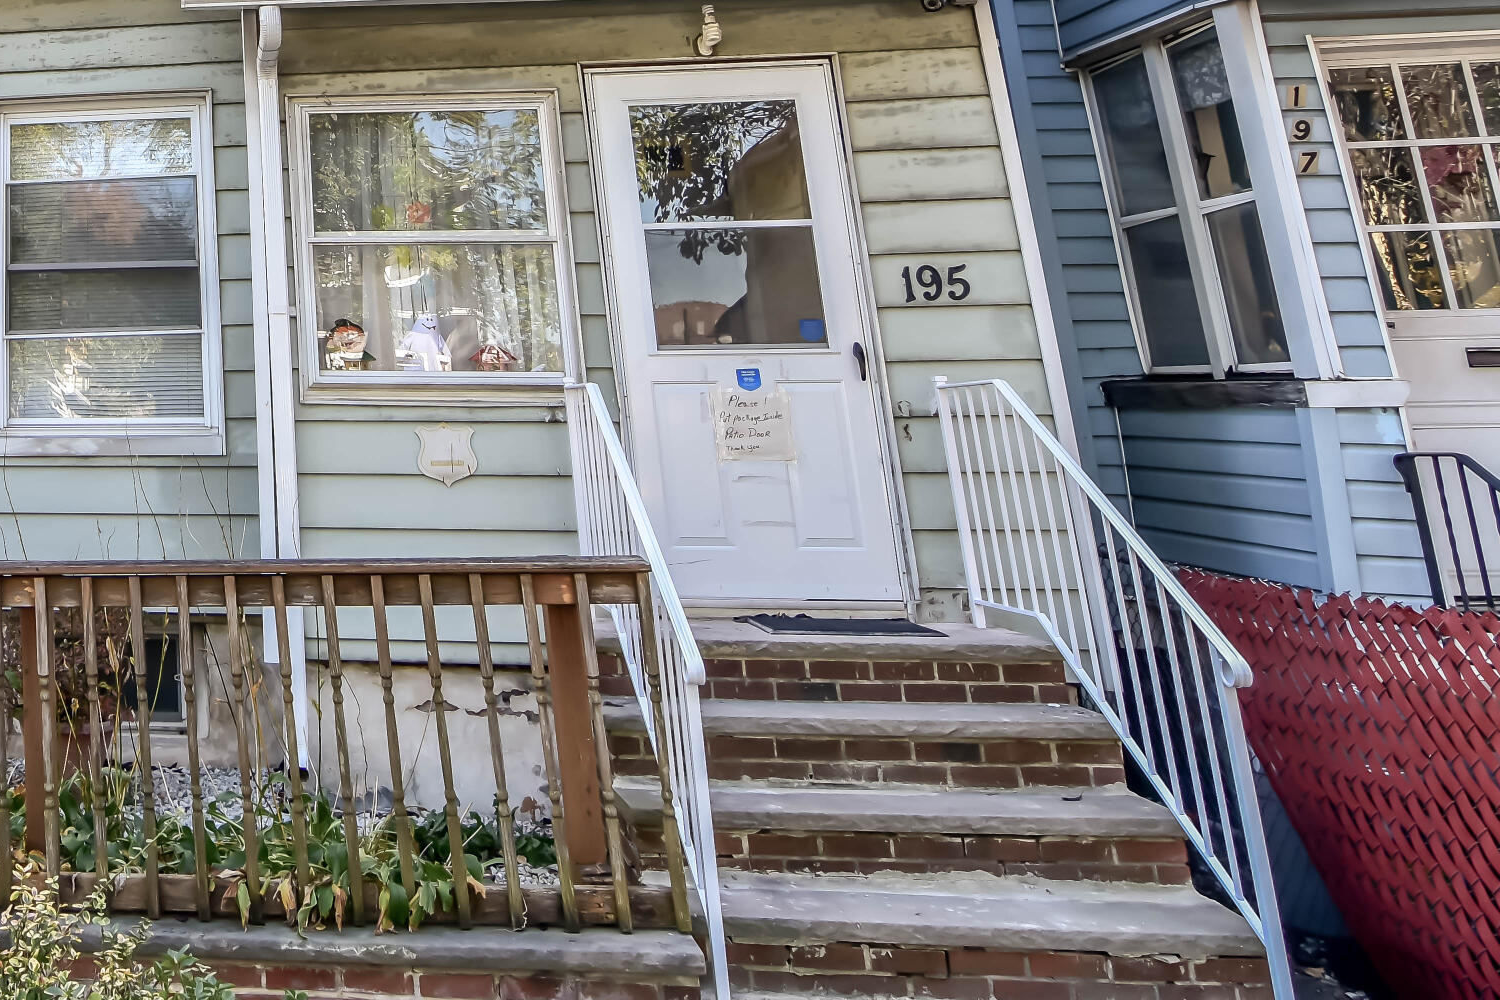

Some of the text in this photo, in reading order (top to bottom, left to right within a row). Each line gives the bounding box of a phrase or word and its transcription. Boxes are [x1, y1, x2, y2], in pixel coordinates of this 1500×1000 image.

[1293, 86, 1318, 173] 197
[902, 264, 970, 303] 195
[728, 395, 758, 407] Please
